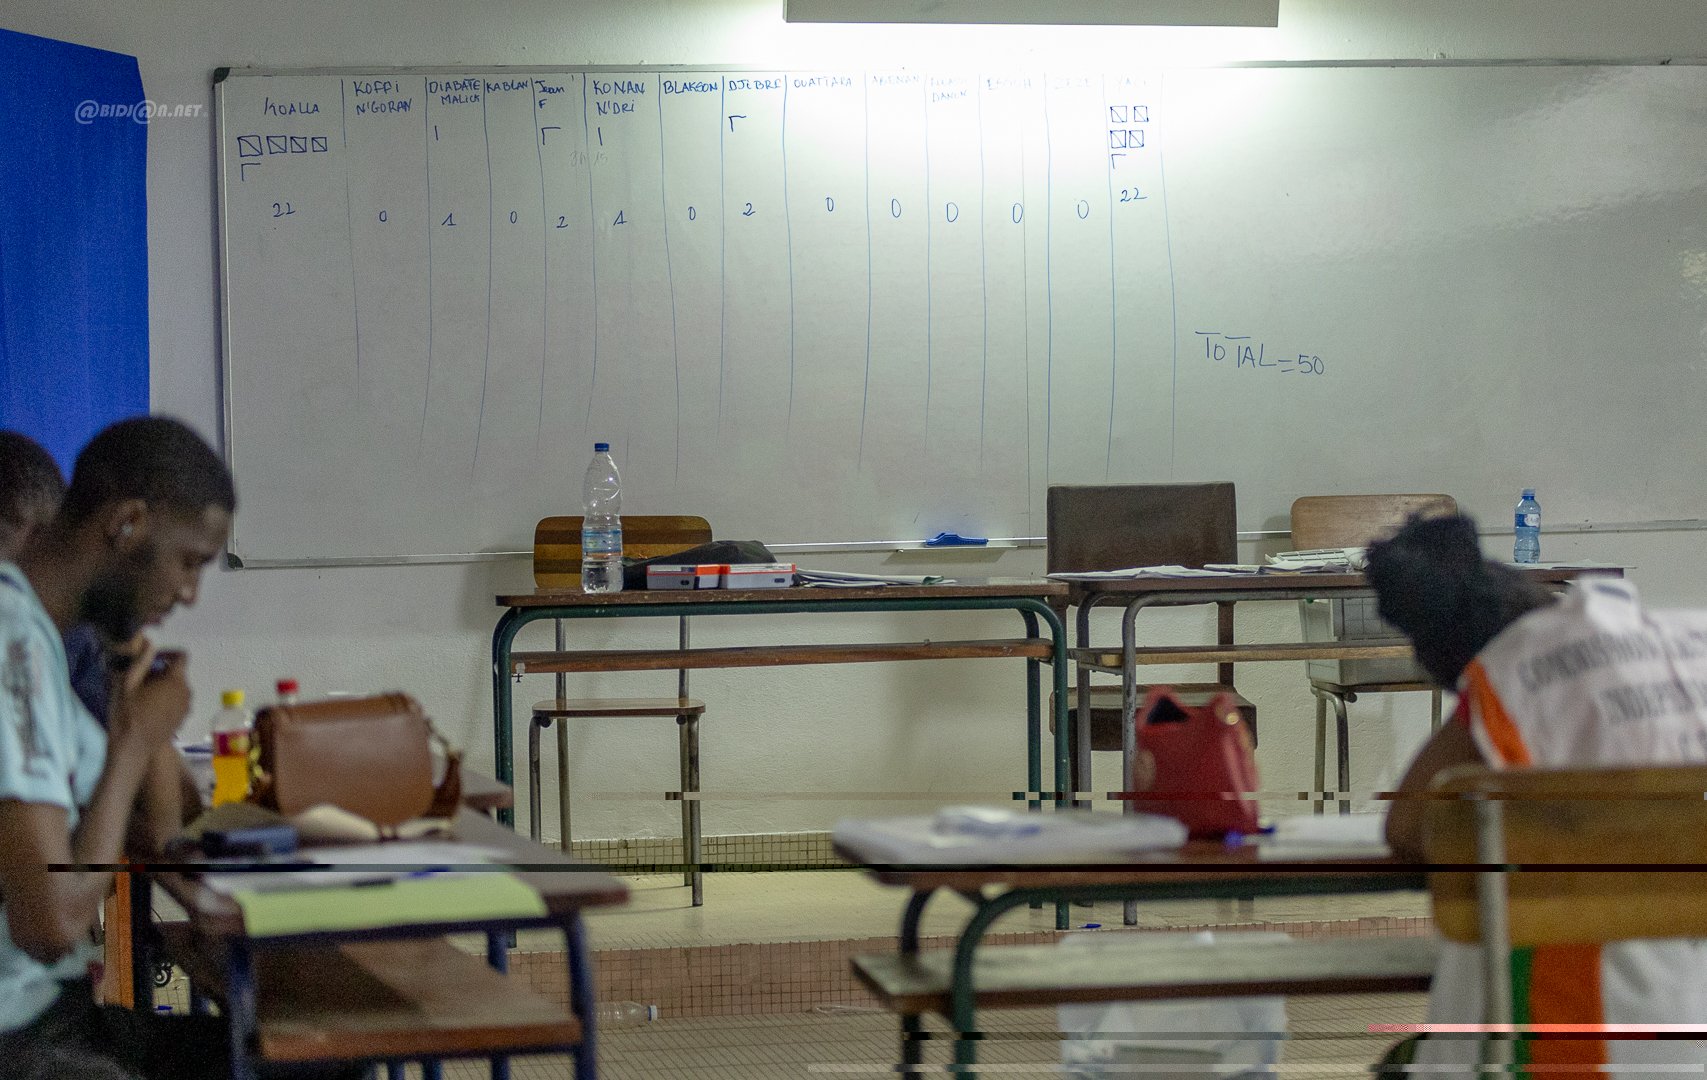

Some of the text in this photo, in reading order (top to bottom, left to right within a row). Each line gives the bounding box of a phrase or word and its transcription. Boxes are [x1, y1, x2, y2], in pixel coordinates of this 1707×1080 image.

[486, 80, 528, 93] KABLAN
[593, 79, 645, 95] KONAN
[1119, 187, 1148, 203] 22
[272, 202, 296, 218] 22
[742, 202, 756, 217] 2
[825, 196, 835, 212] 0
[891, 198, 902, 218] 0
[1077, 200, 1090, 219] 0
[378, 210, 388, 223] 0
[441, 212, 457, 226] 1
[509, 210, 518, 224] 0
[613, 210, 628, 226] 1
[687, 206, 697, 221] 0
[946, 202, 959, 223] 0
[1012, 202, 1024, 224] 0
[556, 216, 569, 229] 2
